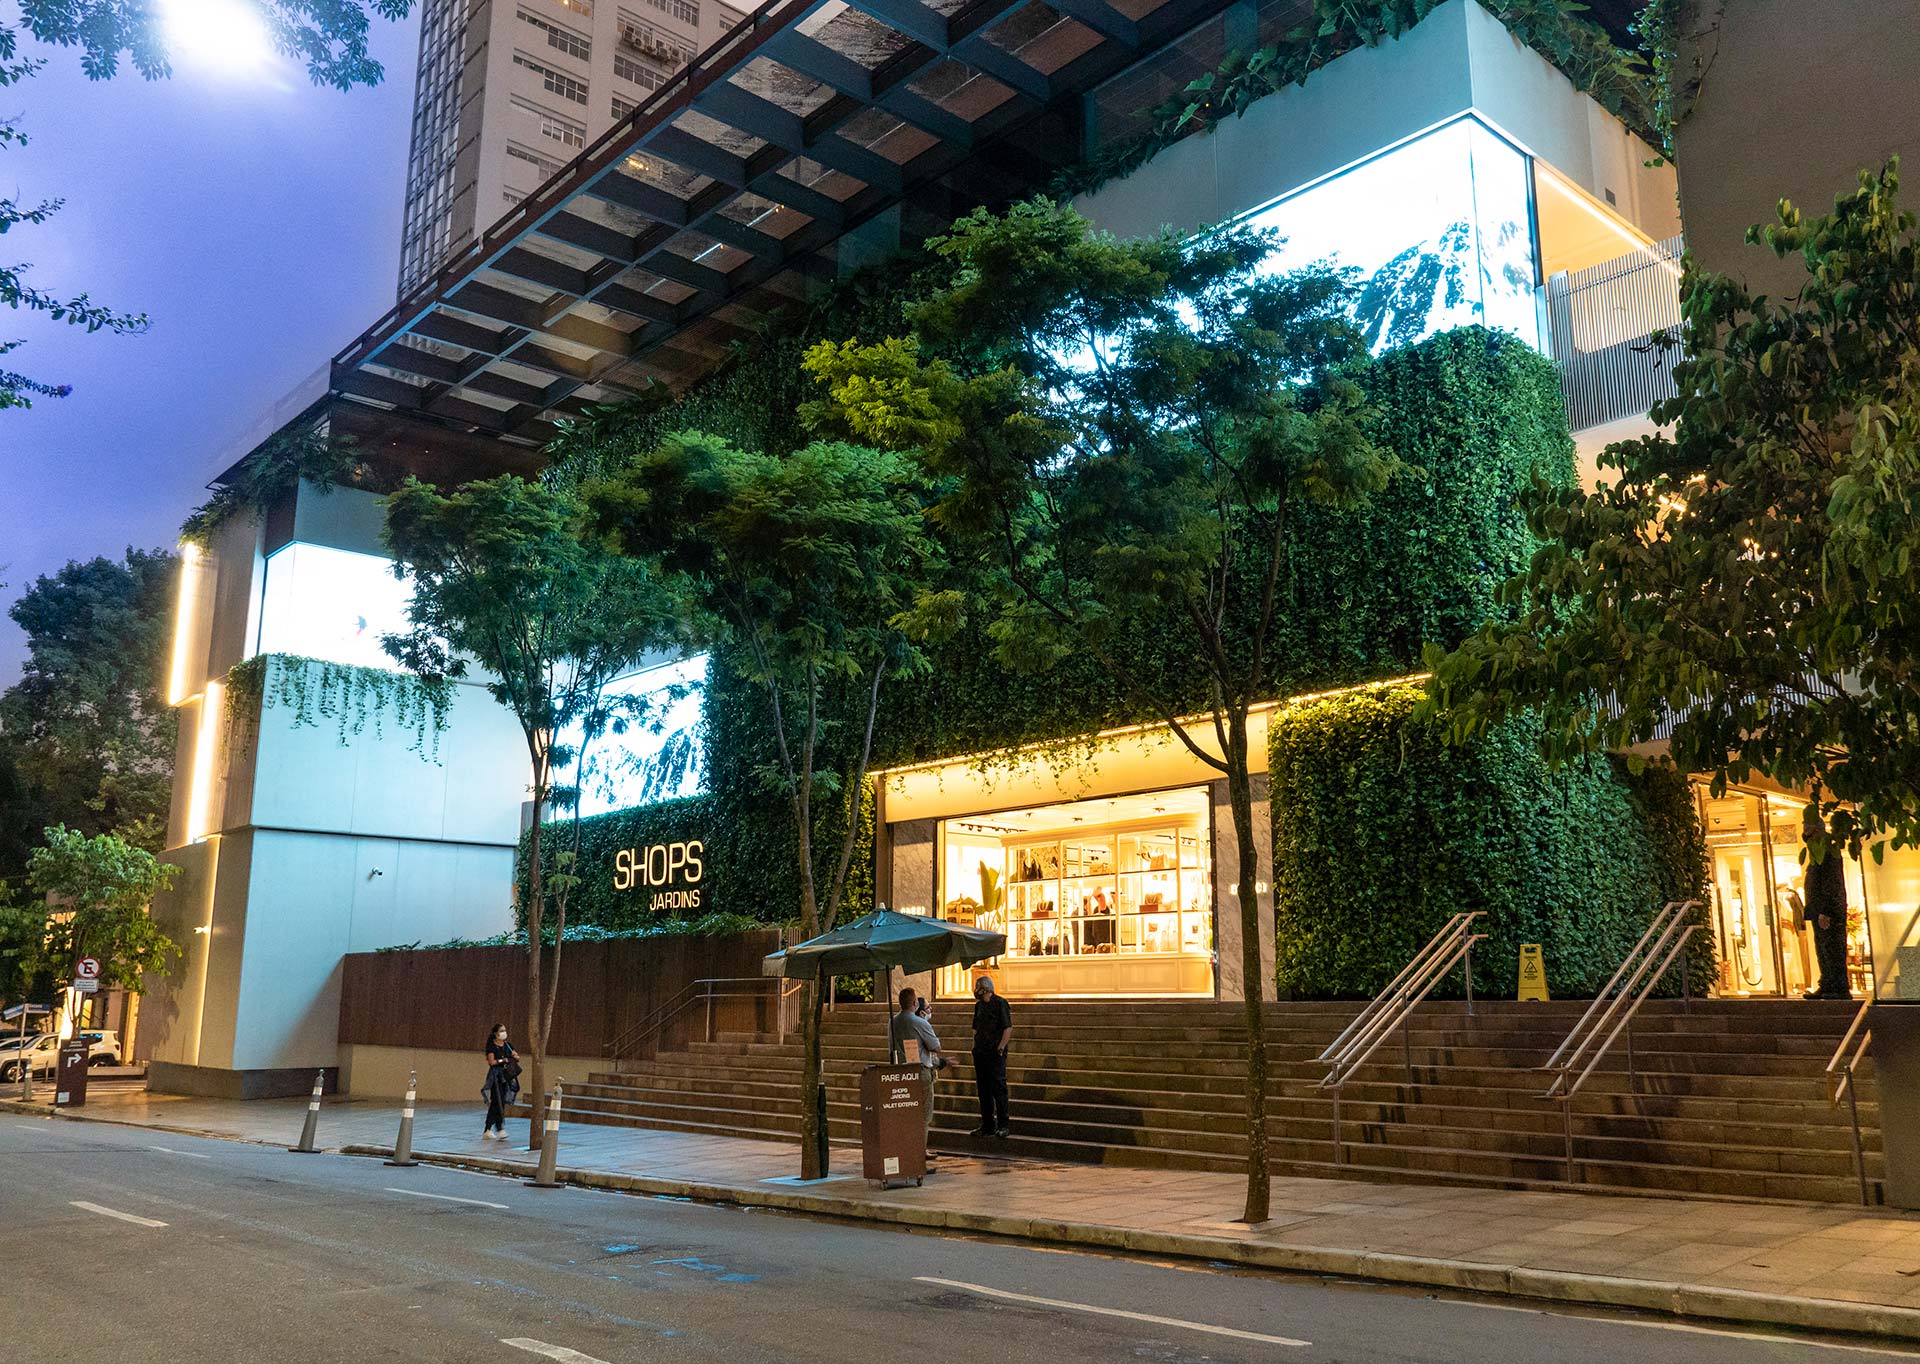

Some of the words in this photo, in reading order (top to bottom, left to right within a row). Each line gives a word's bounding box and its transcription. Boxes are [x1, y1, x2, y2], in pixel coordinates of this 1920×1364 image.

[614, 840, 704, 890] SHOPS
[649, 889, 700, 911] JARDINS
[881, 1074, 900, 1082] PARE
[902, 1073, 919, 1081] AQUI
